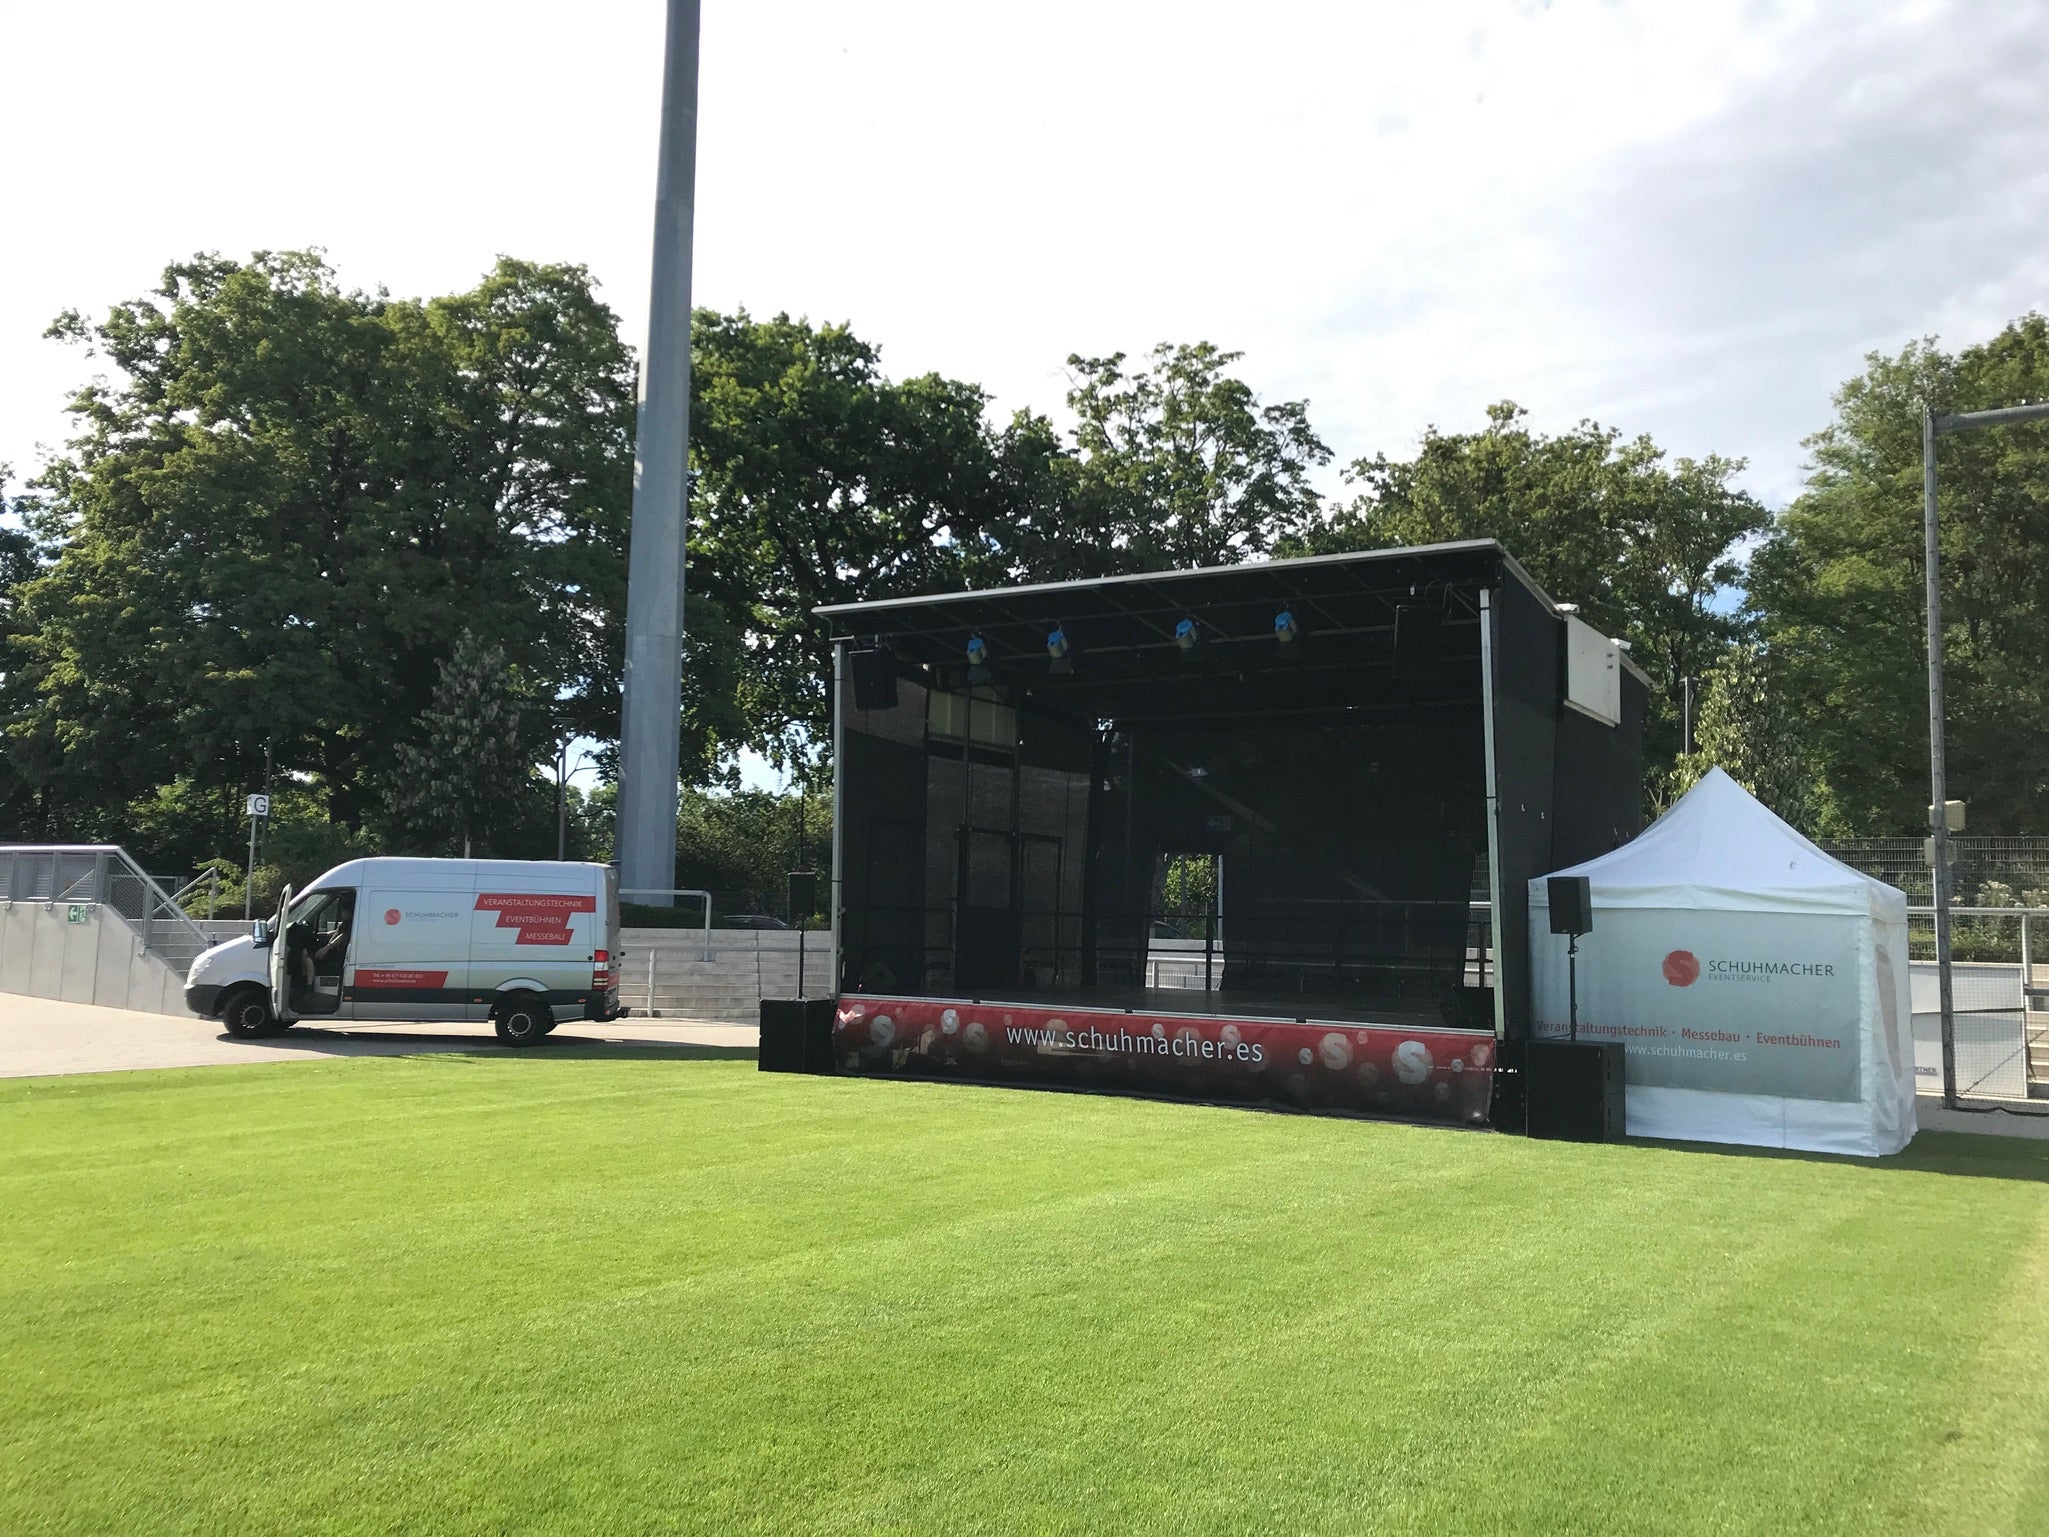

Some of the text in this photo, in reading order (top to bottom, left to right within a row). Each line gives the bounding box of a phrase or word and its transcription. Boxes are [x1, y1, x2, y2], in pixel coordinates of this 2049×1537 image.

[254, 796, 267, 813] G
[483, 898, 583, 908] VERANSTALTUNGSTECHNIK
[505, 915, 562, 924] EVENTBÜHNEN
[525, 932, 566, 940] MESSEBAU
[1708, 960, 1835, 977] SCHUHMACHER
[1708, 973, 1772, 983] EVENTSERVICE
[1006, 1025, 1263, 1063] www.schuhmacher.es
[1681, 1027, 1741, 1042] Messebau
[1756, 1032, 1841, 1049] Eventbühnen
